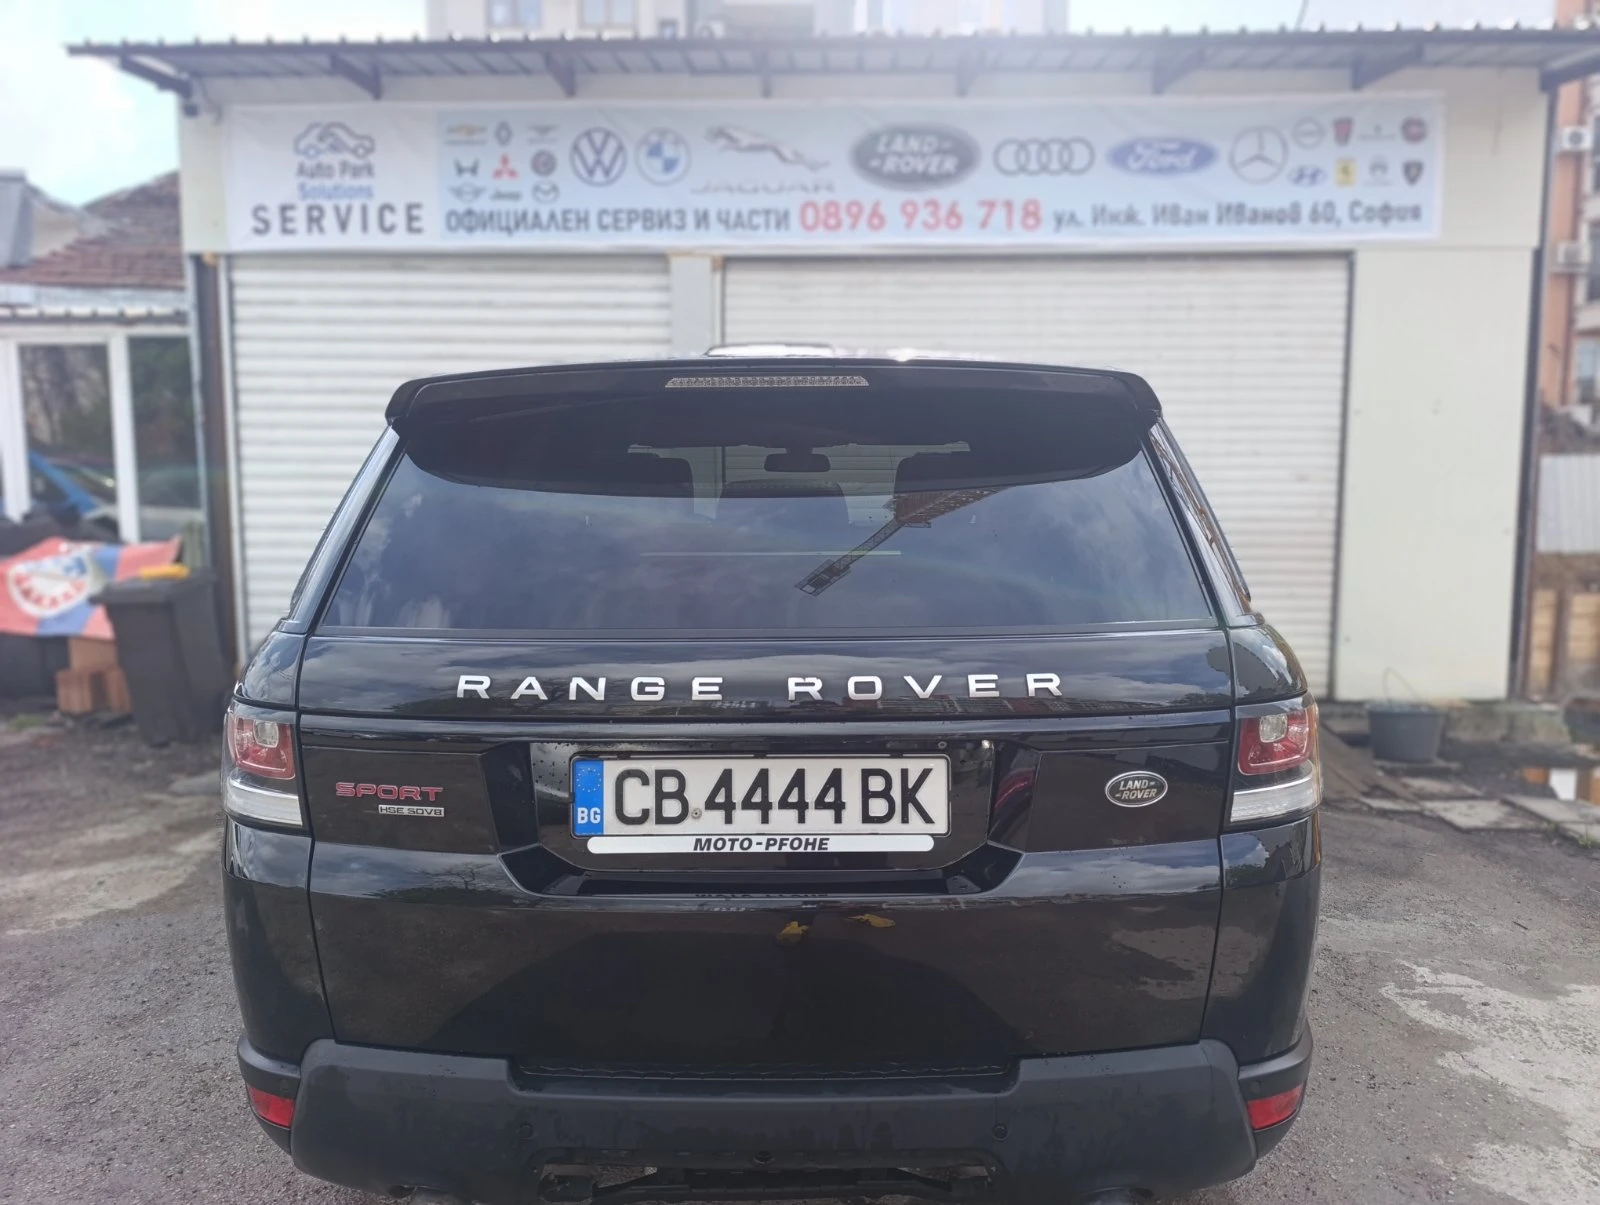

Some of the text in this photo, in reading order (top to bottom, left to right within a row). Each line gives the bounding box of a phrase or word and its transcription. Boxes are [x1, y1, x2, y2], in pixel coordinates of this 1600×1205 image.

[296, 161, 374, 179] Auto Park
[298, 183, 374, 200] Solutions
[251, 202, 424, 235] SERVICE
[445, 208, 590, 236] ОФИЦИАЛЕН
[596, 208, 687, 232] СЕРВИЗ
[694, 209, 710, 232] И
[717, 208, 790, 232] ЧАСТИ
[799, 199, 887, 232] 0896
[900, 199, 964, 232] 936
[977, 199, 1043, 232] 718
[456, 672, 1064, 701] RANGE ROVER
[335, 782, 444, 801] SPORT
[380, 806, 405, 815] HSE
[577, 806, 602, 825] BG
[693, 836, 830, 852] MOTO-PFOHE
